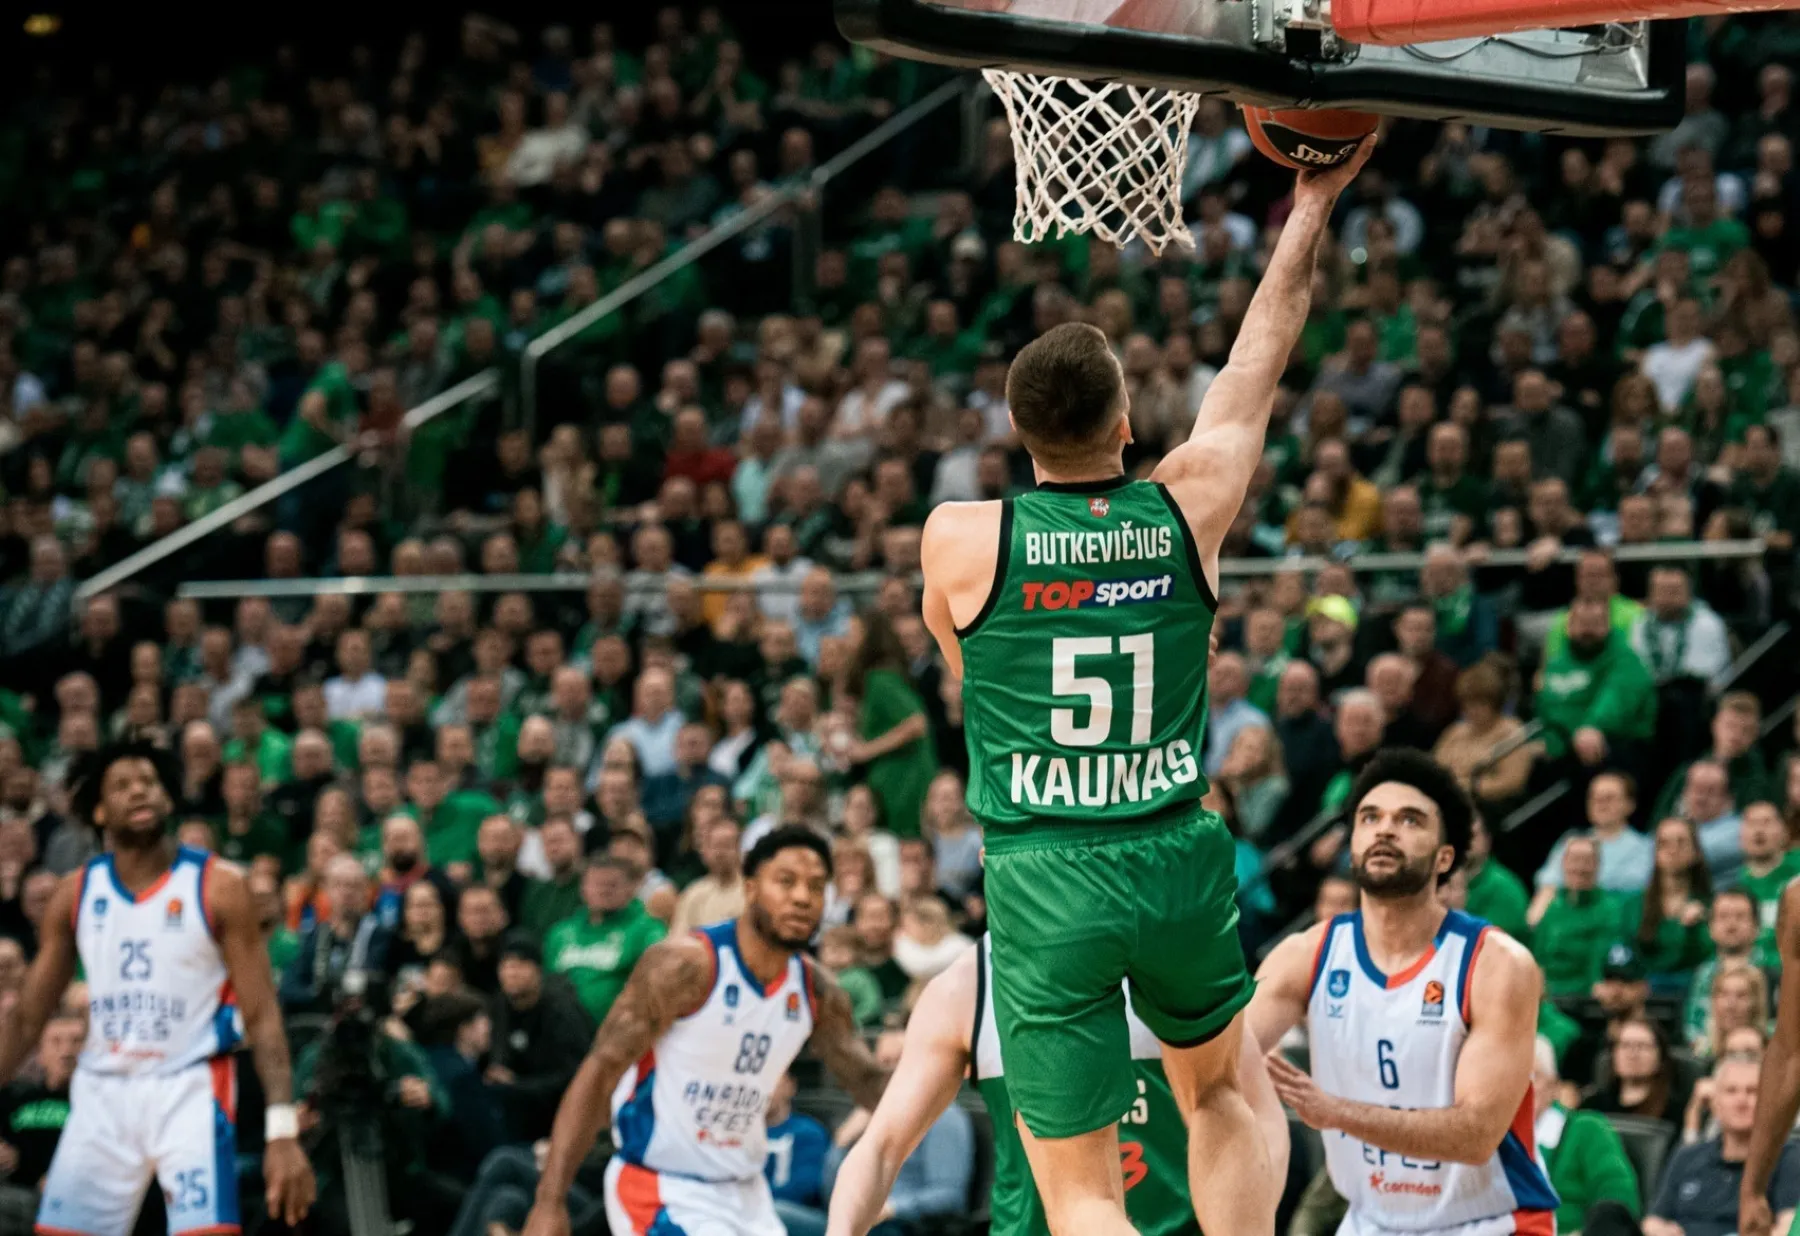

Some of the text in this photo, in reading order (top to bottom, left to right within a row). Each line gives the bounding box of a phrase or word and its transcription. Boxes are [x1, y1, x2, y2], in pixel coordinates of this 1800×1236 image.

[1026, 521, 1172, 565] BUTKEVIČIUS
[1022, 575, 1172, 610] TOPsport
[1050, 633, 1154, 747] 51
[1011, 739, 1199, 807] KAUNAS
[119, 938, 152, 981] 25
[1377, 1039, 1399, 1089] 6
